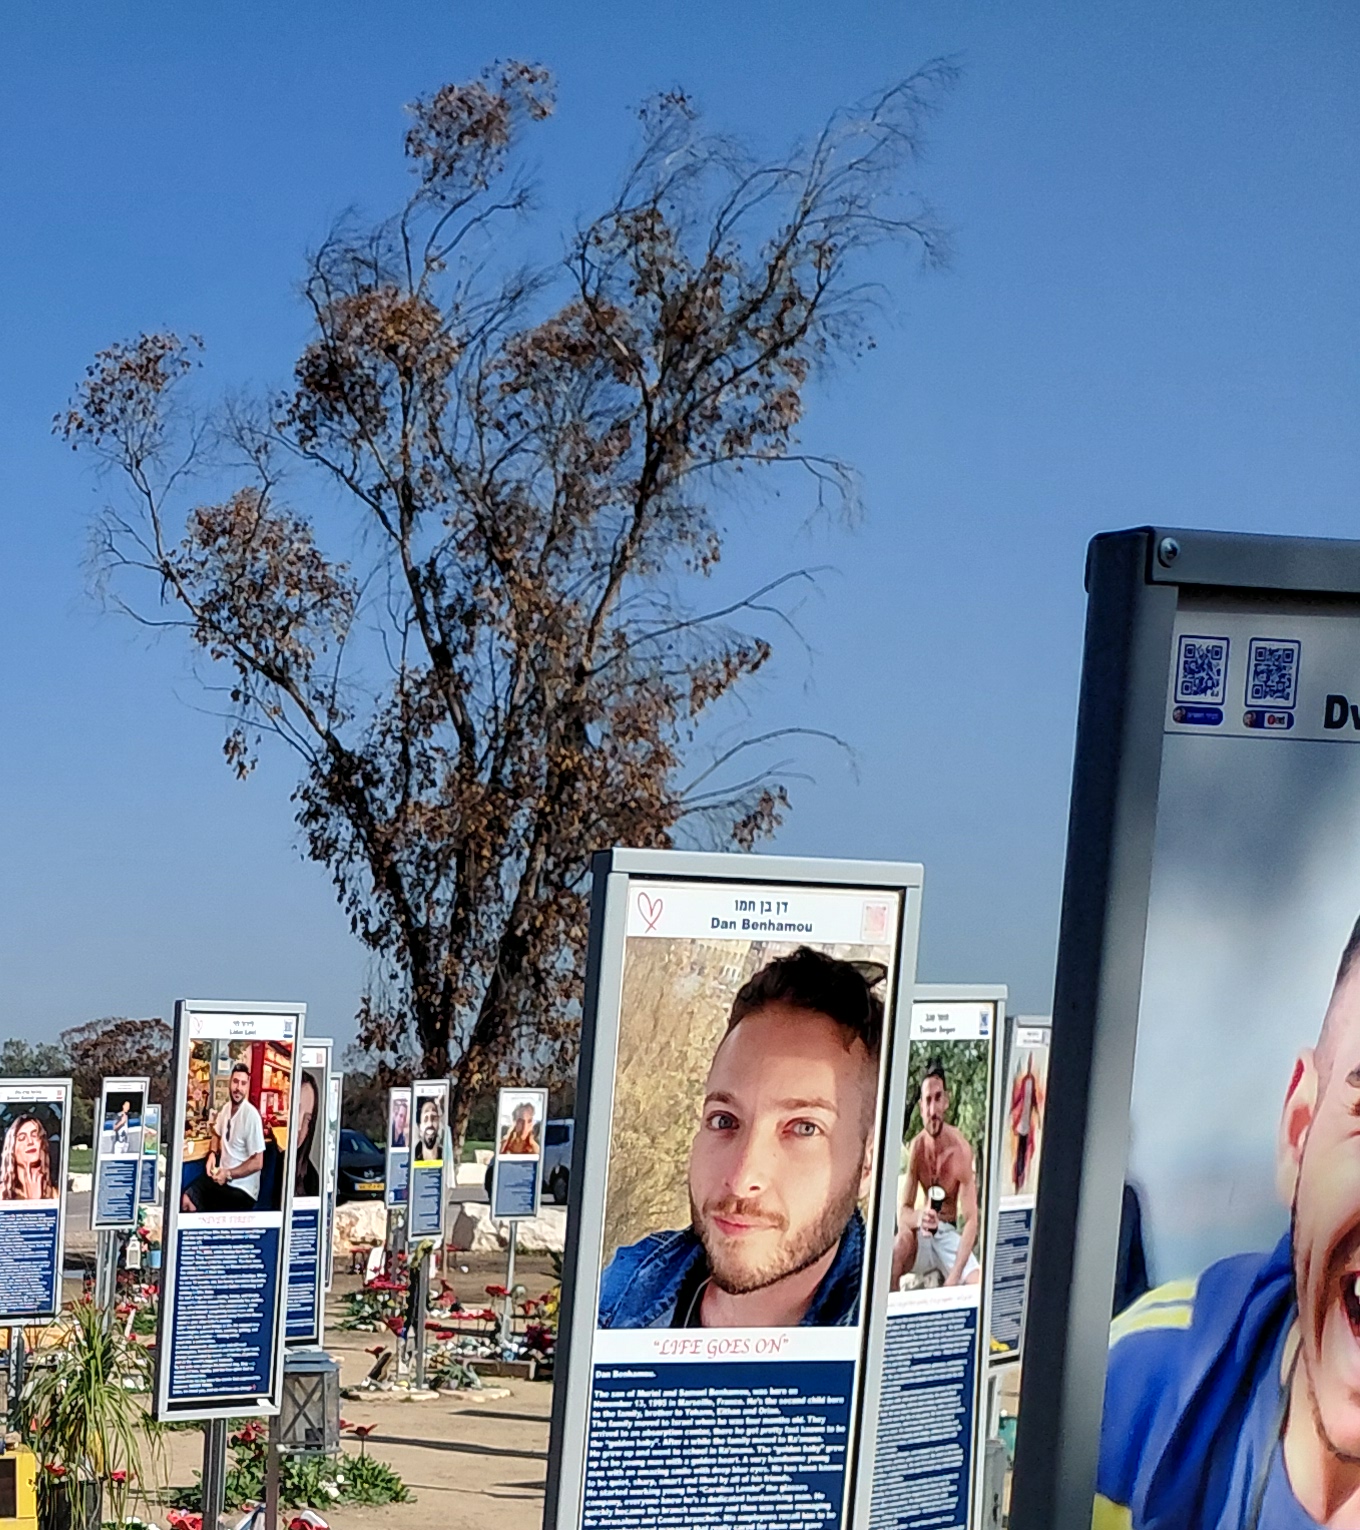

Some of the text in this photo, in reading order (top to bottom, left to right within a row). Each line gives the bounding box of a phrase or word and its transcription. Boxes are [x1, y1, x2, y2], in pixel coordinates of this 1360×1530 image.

[735, 899, 789, 914] דן בן חמו
[710, 917, 813, 933] Dan Benhamou
[707, 1338, 751, 1359] GOES
